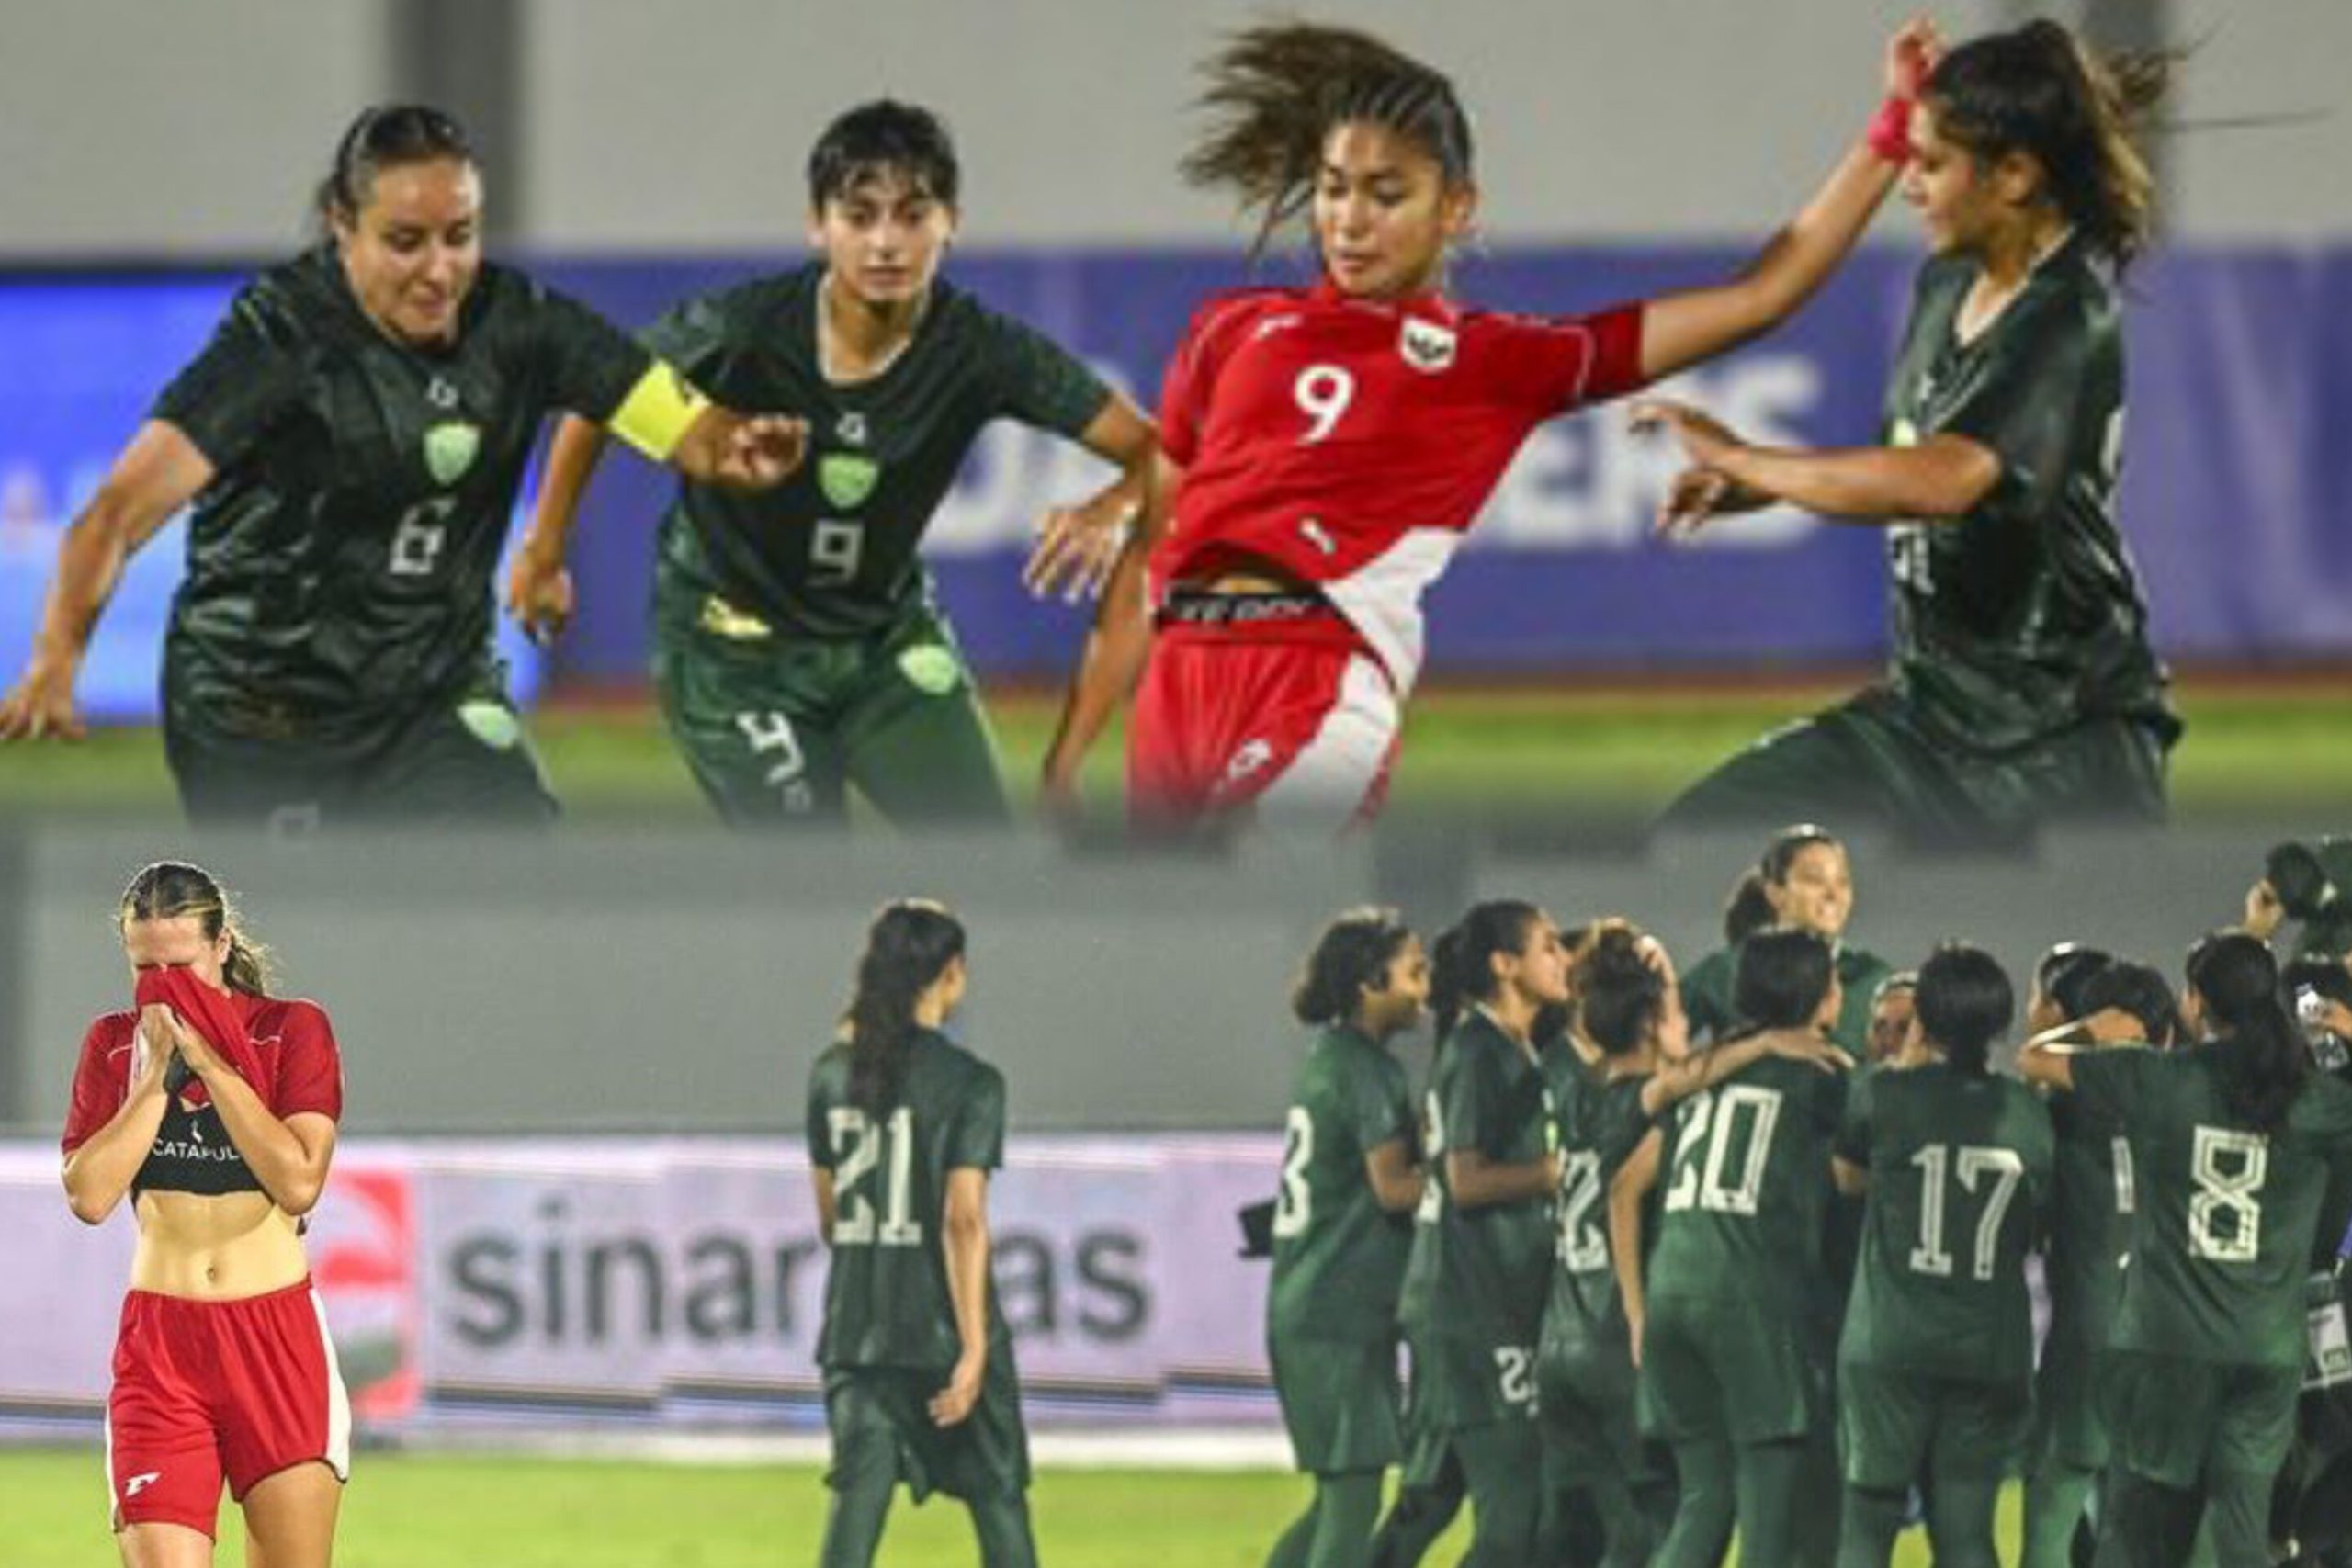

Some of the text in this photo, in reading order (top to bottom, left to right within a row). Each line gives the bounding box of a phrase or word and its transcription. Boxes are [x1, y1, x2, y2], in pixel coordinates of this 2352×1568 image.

[1293, 364, 1355, 447] 9
[390, 499, 454, 574] 6
[807, 519, 865, 586] 9
[826, 1106, 922, 1244] 21
[1556, 1145, 1608, 1273] 2
[1664, 1083, 1783, 1215] 20
[1909, 1144, 2023, 1280] 17
[2189, 1124, 2269, 1262] 8
[1494, 1346, 1539, 1403] 2
